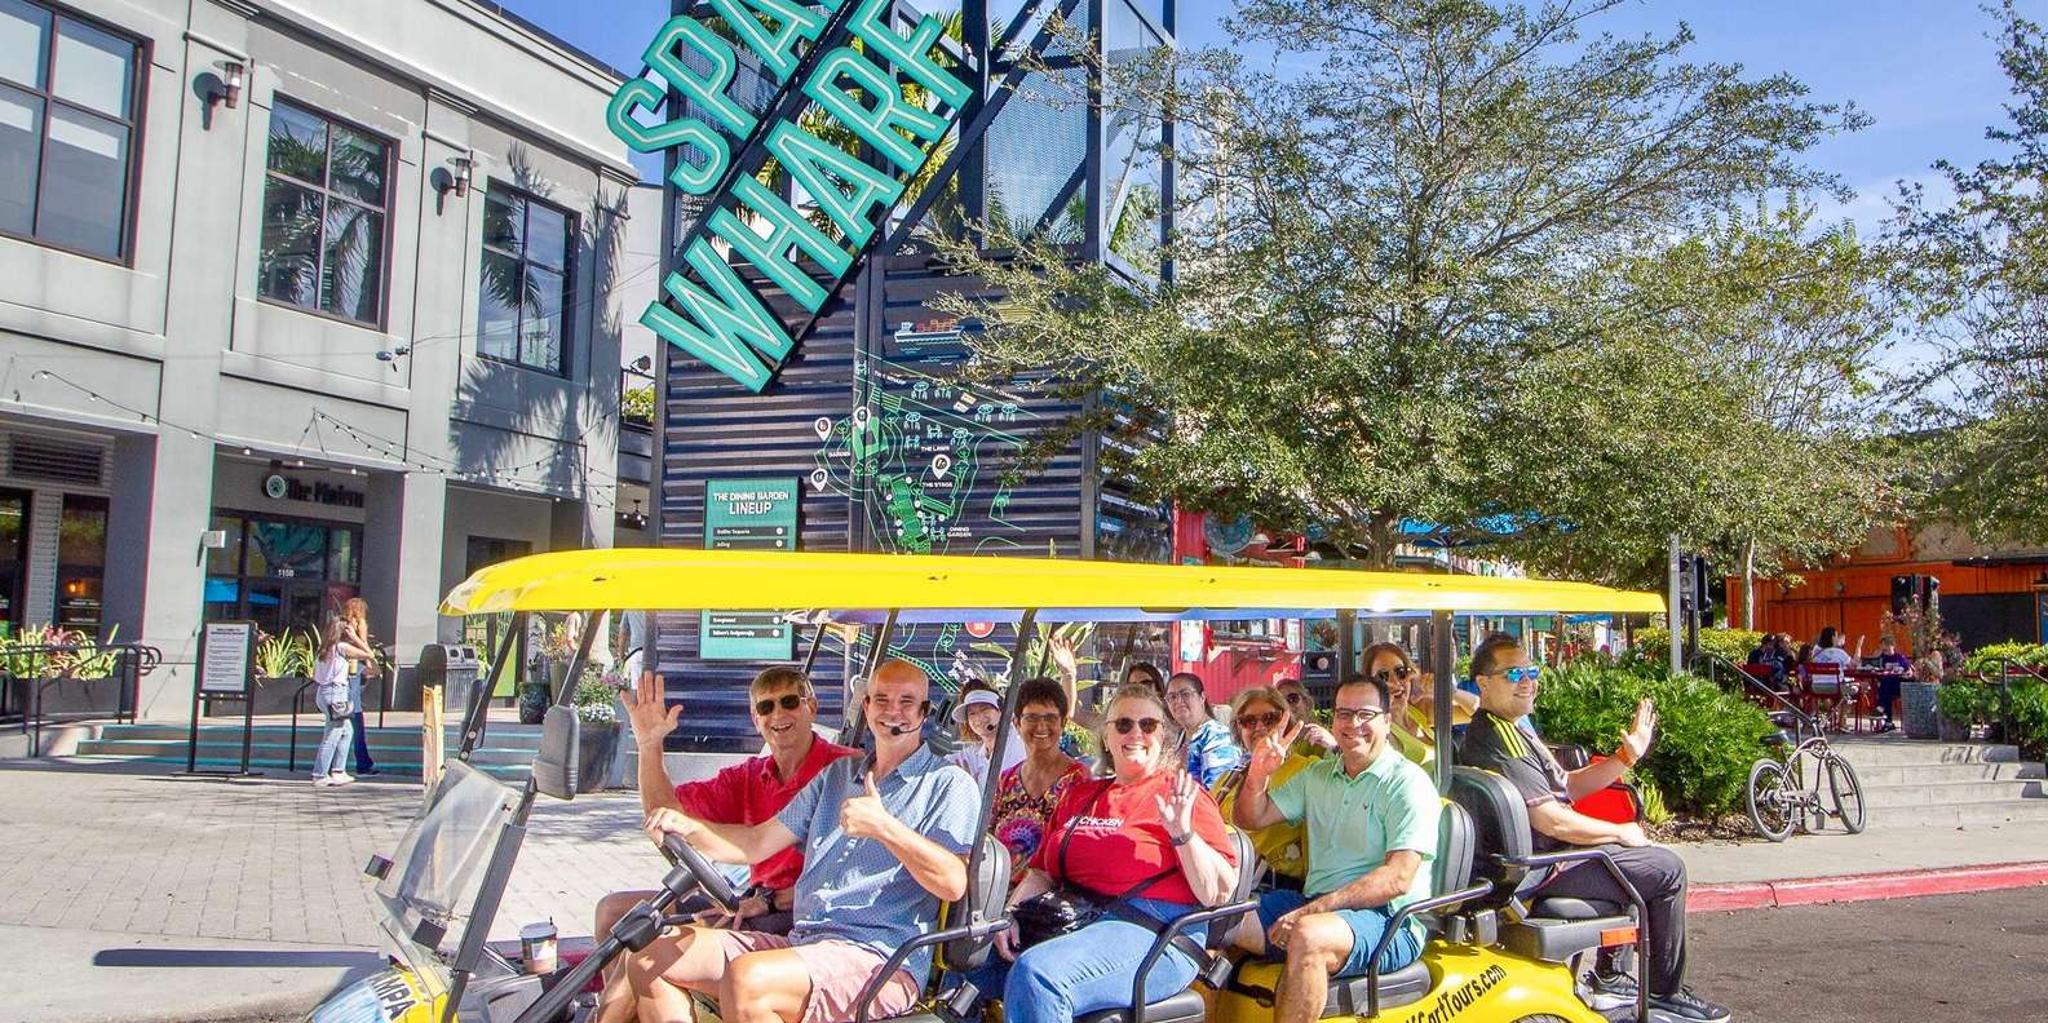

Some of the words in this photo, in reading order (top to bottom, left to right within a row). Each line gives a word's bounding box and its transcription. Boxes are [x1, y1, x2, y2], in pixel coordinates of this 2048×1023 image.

[606, 0, 846, 195] SPA
[639, 0, 973, 393] WHARF
[713, 492, 729, 502] THE
[729, 491, 756, 501] DINING
[756, 490, 789, 501] GARDEN
[729, 502, 772, 515] LINEUP
[1079, 816, 1124, 828] CHICKEN
